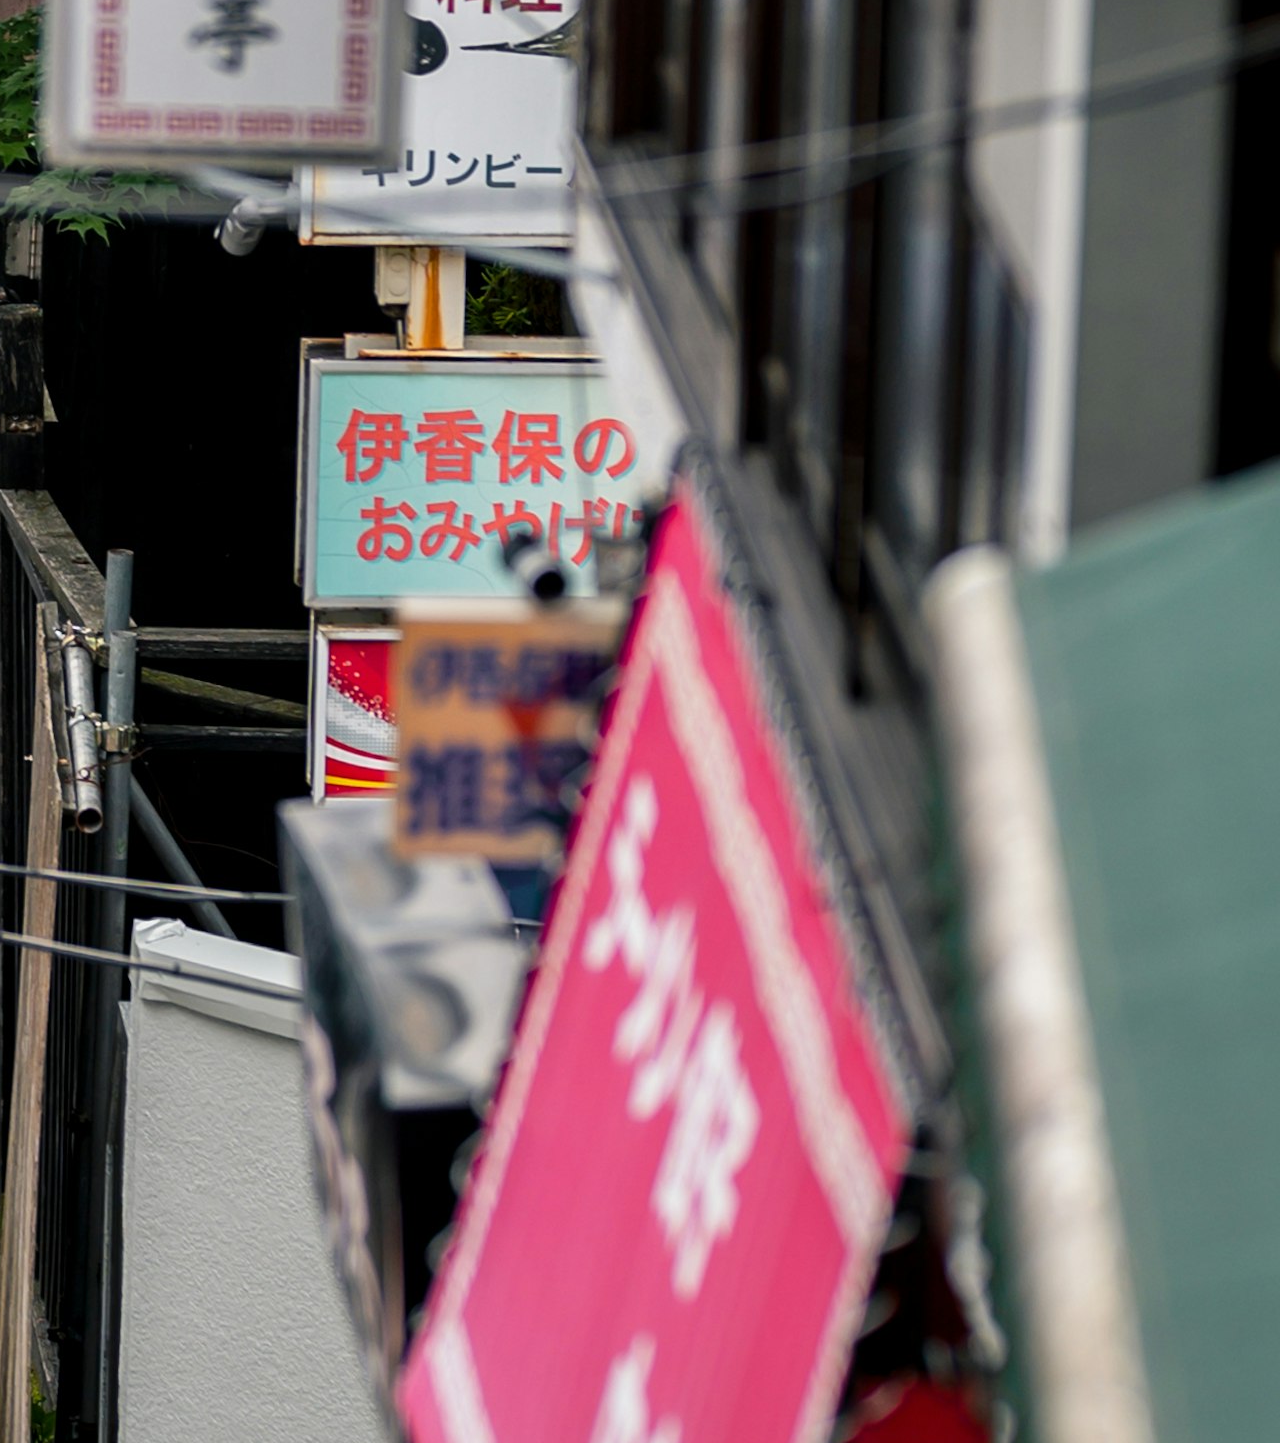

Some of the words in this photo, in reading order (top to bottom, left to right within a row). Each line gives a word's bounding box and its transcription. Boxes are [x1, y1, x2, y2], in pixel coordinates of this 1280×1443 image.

[362, 149, 577, 189] リンビー
[336, 408, 637, 484] 伊香保の
